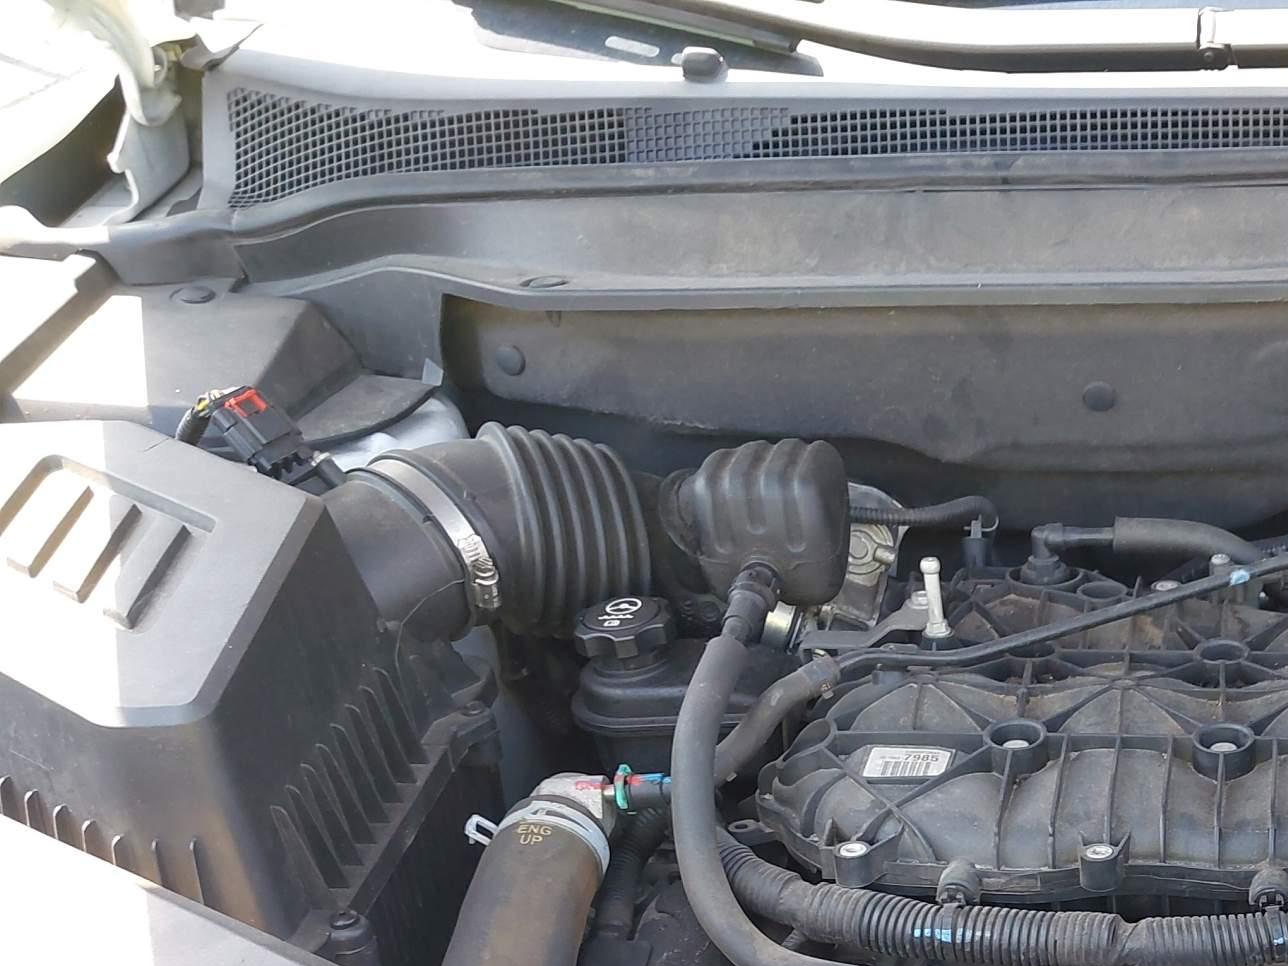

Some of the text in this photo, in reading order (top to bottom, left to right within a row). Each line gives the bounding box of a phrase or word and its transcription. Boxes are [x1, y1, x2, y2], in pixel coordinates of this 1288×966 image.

[904, 754, 939, 762] 7985
[518, 824, 553, 835] ENG
[520, 834, 543, 845] UP
